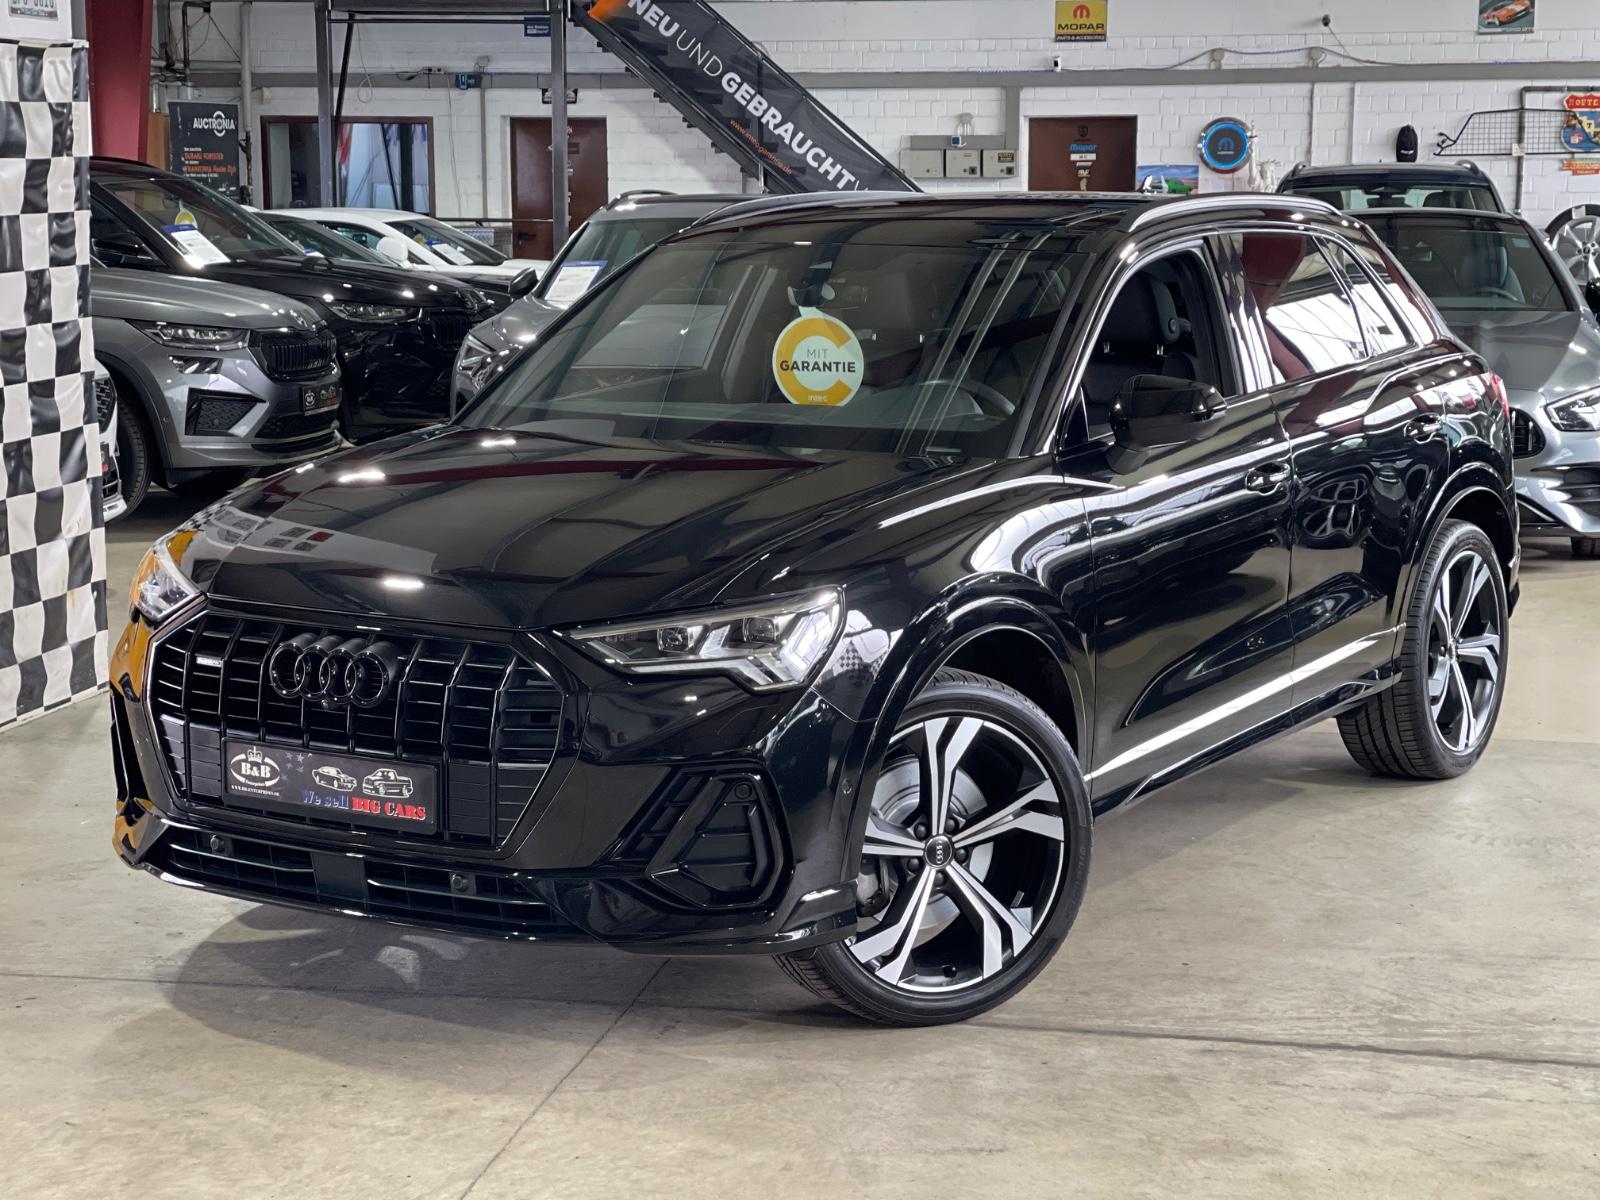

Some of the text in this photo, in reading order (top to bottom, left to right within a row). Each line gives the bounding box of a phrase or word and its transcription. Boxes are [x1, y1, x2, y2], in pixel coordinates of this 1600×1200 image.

[1057, 23, 1105, 31] MOPAR
[627, 0, 856, 190] NEU UND GEBRAUCHT
[193, 116, 236, 131] AUCTRONIA
[806, 348, 829, 359] MIT
[779, 359, 856, 373] GARANTIE
[240, 761, 271, 778] B&B
[303, 789, 427, 821] We sell BIG CARS
